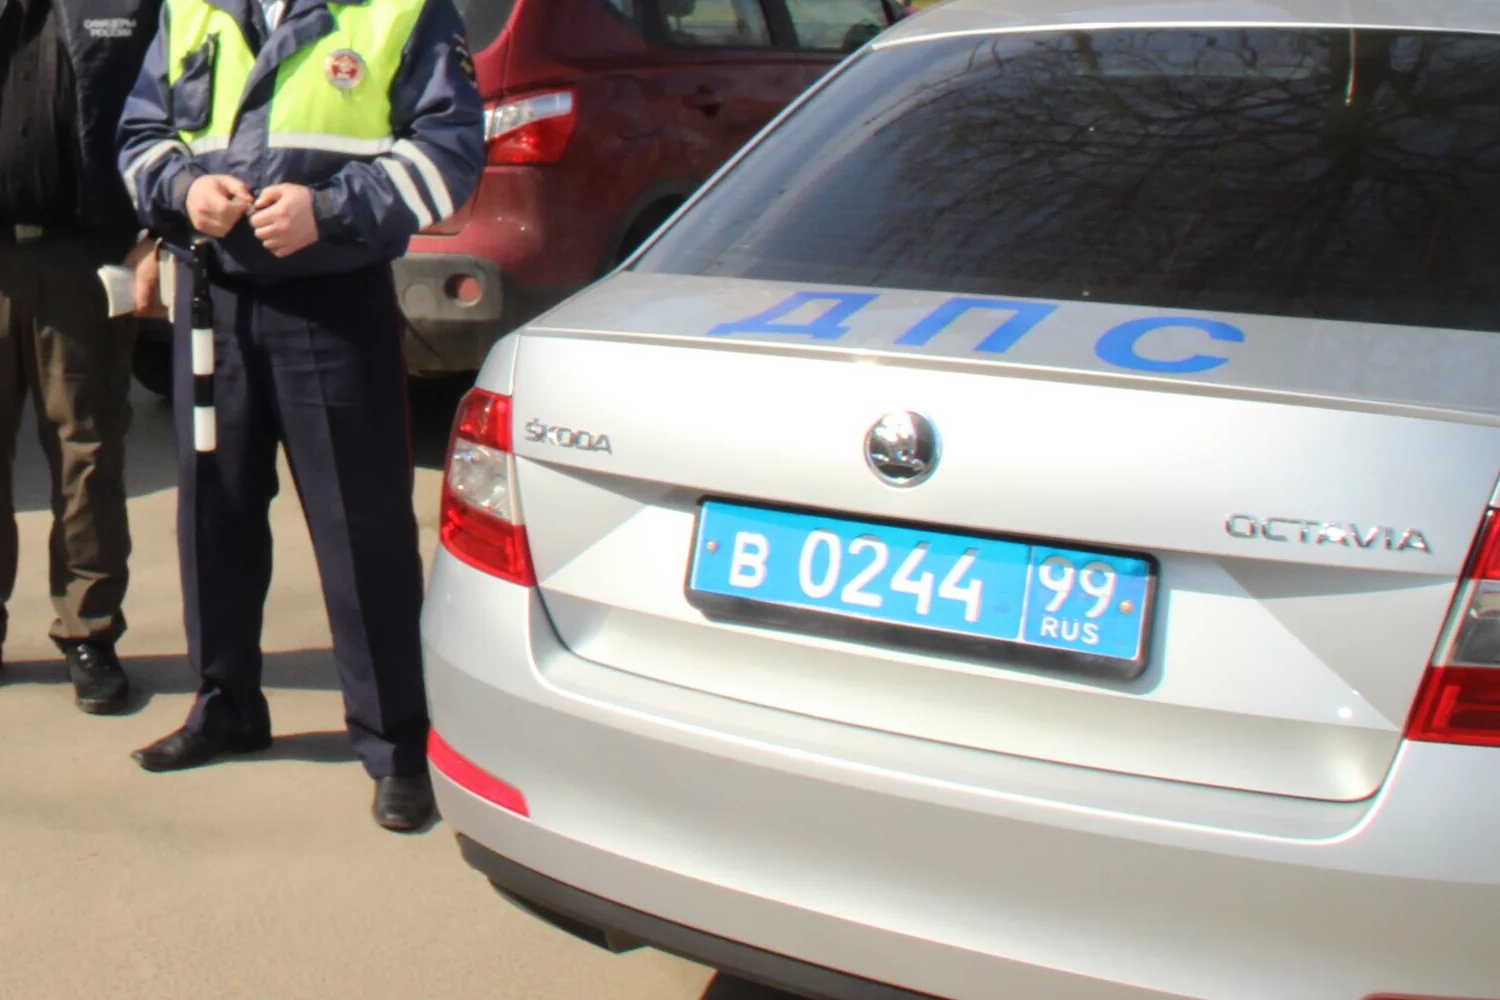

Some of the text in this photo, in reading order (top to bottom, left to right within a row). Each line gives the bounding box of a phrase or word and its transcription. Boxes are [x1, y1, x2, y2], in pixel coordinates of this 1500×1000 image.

[706, 290, 1246, 374] ДПС
[1224, 513, 1432, 554] OCTAVIA
[798, 526, 985, 623] 0244
[1037, 554, 1117, 618] 99
[1038, 616, 1101, 646] RUS
